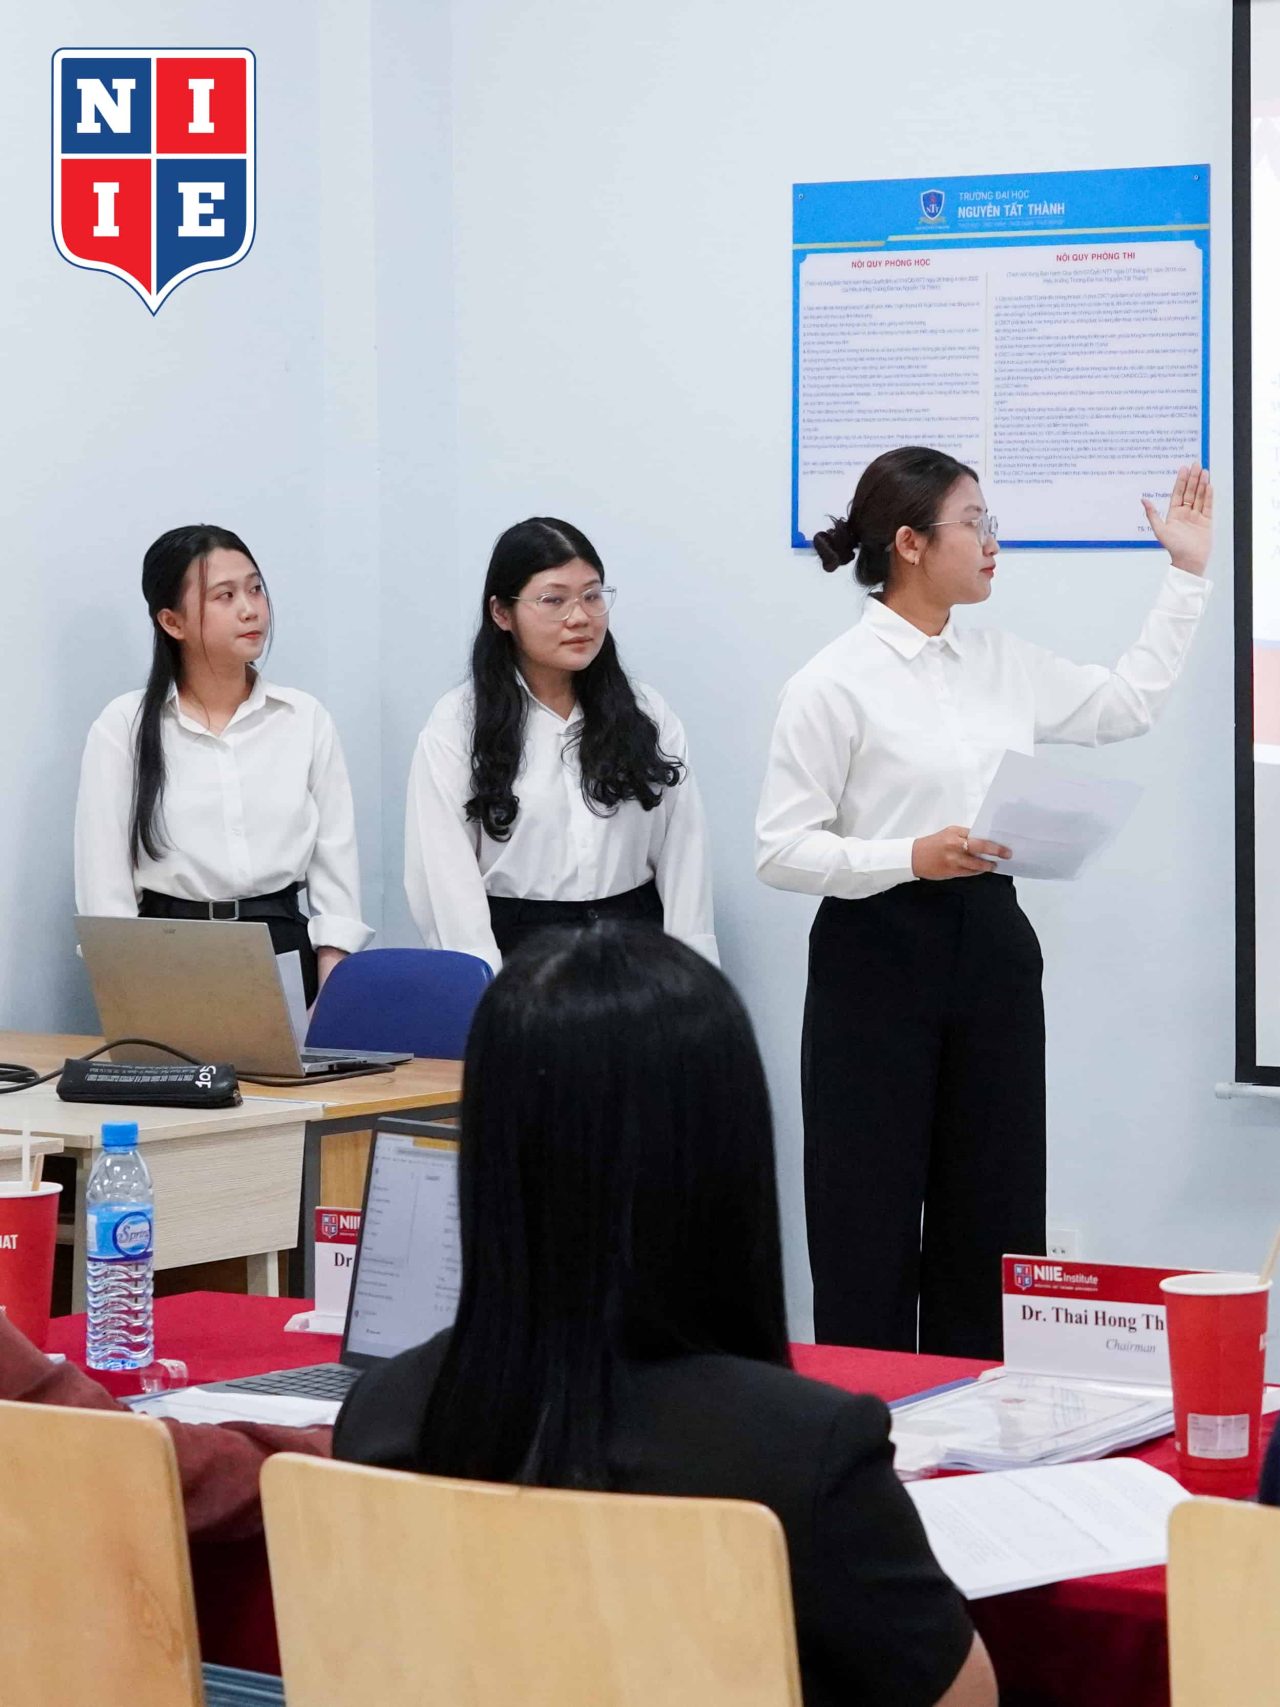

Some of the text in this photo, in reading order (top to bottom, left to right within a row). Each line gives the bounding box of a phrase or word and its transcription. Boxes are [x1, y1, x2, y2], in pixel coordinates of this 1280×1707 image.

[1004, 201, 1023, 217] TẤT
[1028, 200, 1065, 216] THÀNH
[1123, 251, 1136, 260] THI
[1033, 1265, 1099, 1285] NIIE Institute
[1021, 1304, 1165, 1333] Dr. Thai Hong Th
[1105, 1338, 1156, 1354] Chairman
